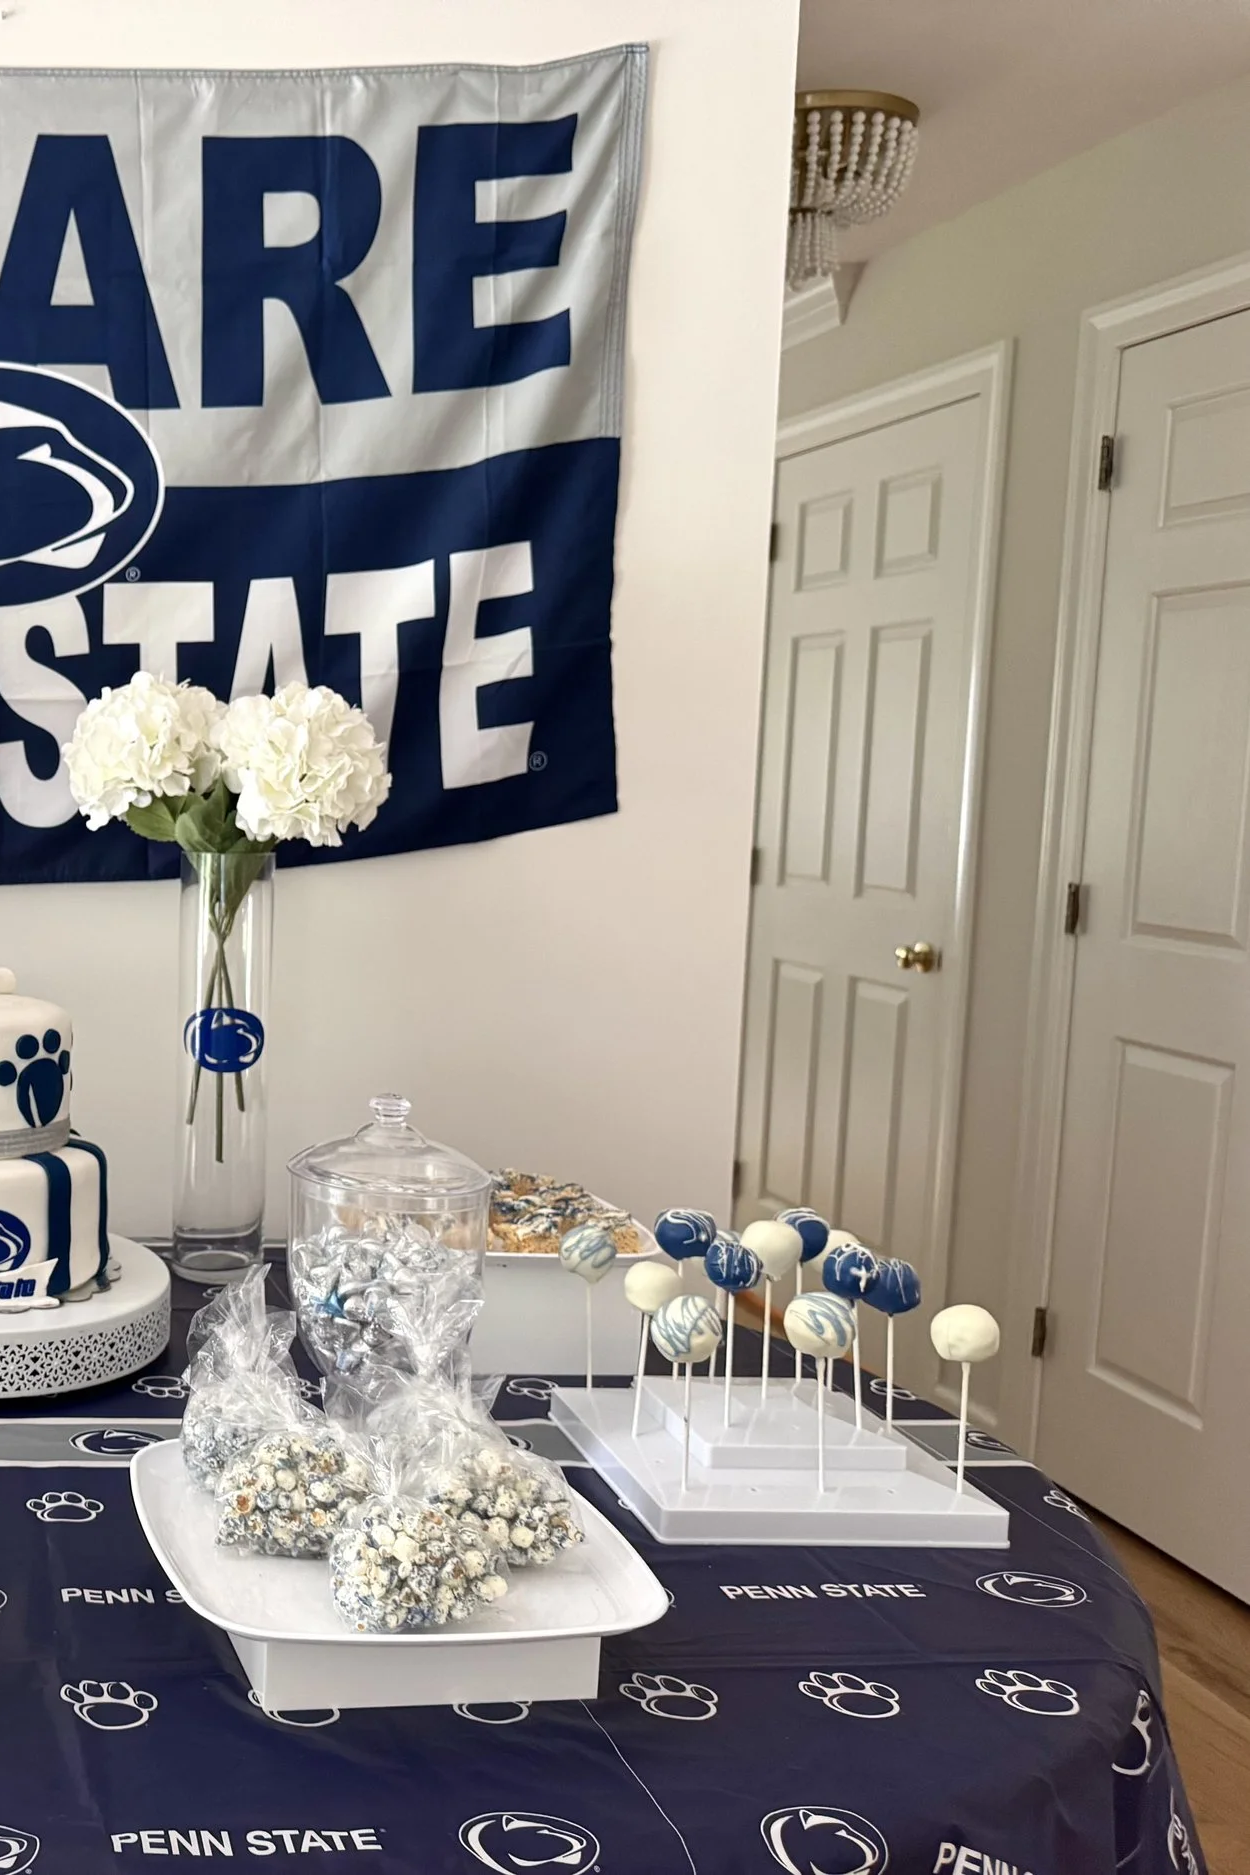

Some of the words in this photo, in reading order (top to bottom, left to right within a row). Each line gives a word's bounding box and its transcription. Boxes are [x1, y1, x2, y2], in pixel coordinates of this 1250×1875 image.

[60, 1587, 155, 1605] PENN
[719, 1584, 818, 1600] PENN
[820, 1583, 927, 1599] STATE
[110, 1830, 234, 1857] PENN
[246, 1828, 383, 1856] STATE
